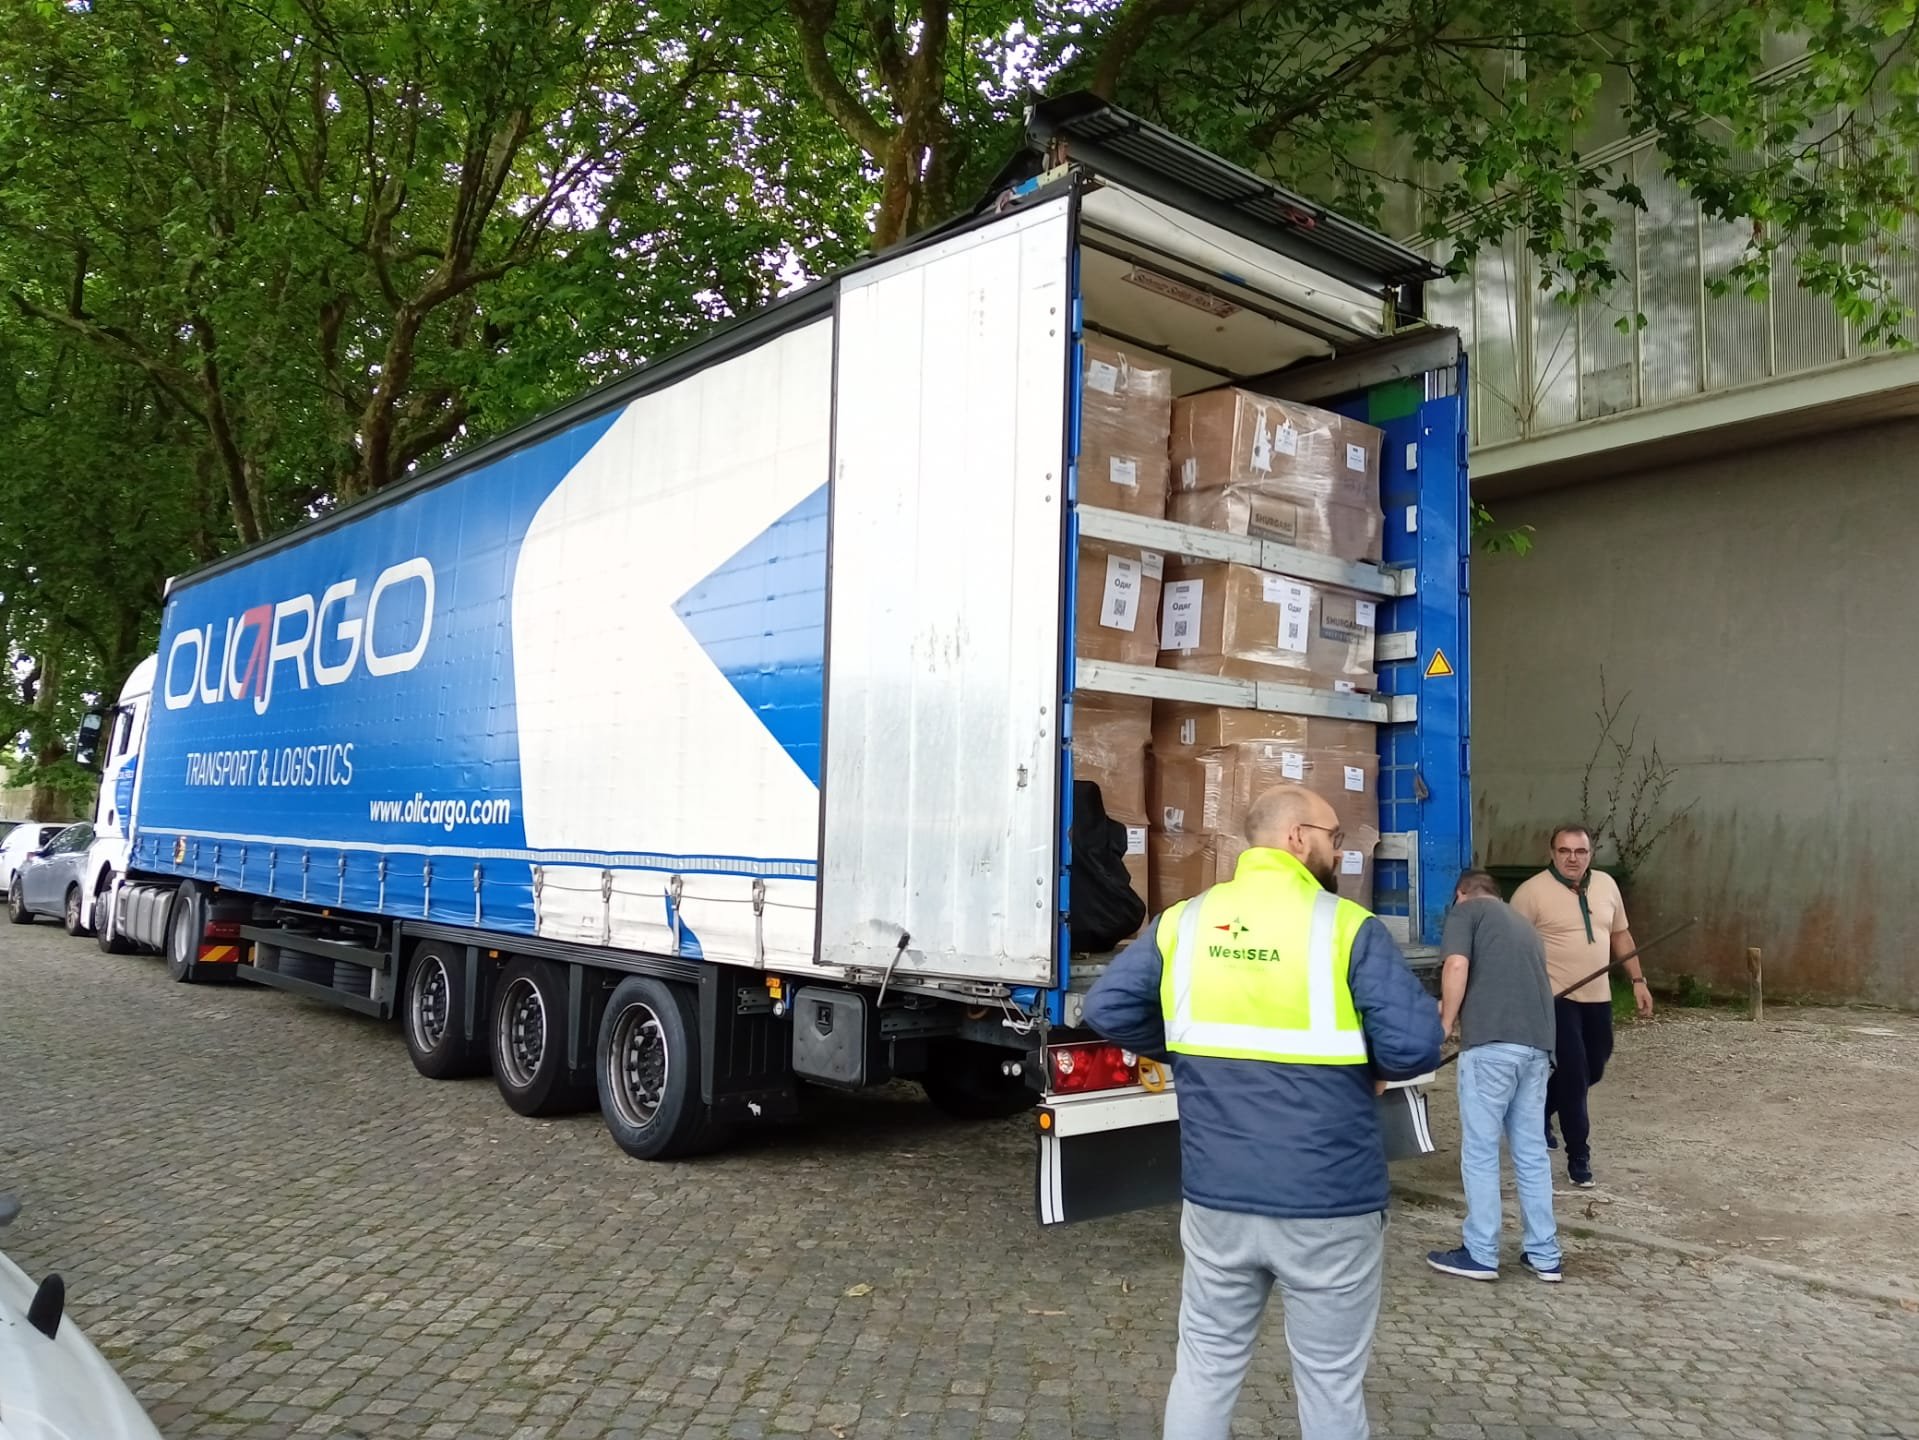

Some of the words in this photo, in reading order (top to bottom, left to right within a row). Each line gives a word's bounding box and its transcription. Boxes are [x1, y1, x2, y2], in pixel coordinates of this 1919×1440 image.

[164, 557, 435, 715] OLICARGO
[185, 749, 257, 786] TRANSPORT
[258, 752, 268, 785] &
[272, 743, 354, 787] LOGISTICS
[370, 793, 511, 831] www.olicargo.com
[1209, 945, 1280, 961] WestSEA
